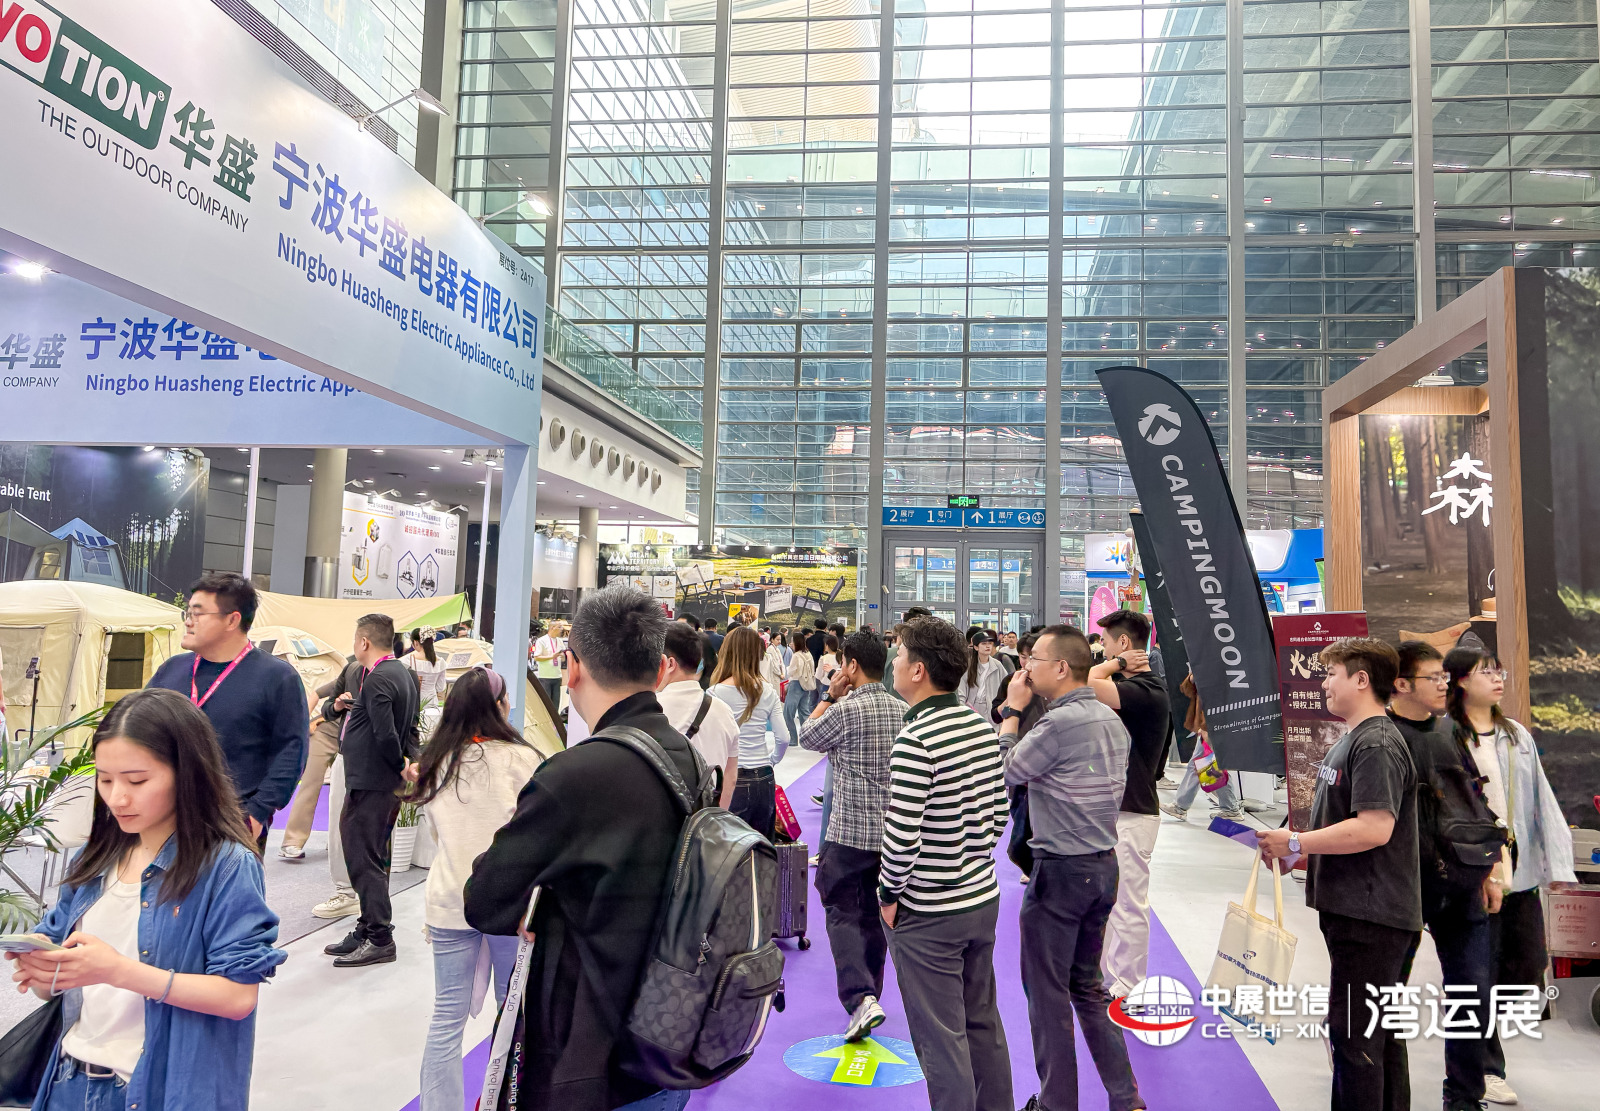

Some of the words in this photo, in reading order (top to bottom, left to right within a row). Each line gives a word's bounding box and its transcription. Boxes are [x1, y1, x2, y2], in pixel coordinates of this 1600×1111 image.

[38, 99, 77, 140] THE
[82, 127, 173, 193] OUTDOOR
[176, 181, 249, 233] COMPANY
[169, 100, 258, 203] 华盛
[272, 141, 538, 359] 宁波华盛电器有限公司
[520, 268, 534, 288] 2A17
[277, 232, 338, 287] Ningbo
[341, 273, 409, 331] Huasheng
[411, 309, 453, 349] Electric
[454, 333, 502, 375] Appliance
[521, 369, 535, 391] Ltd
[0, 333, 67, 370] 华盛
[80, 317, 278, 361] 宁波华盛
[3, 377, 60, 388] COMPANY
[86, 374, 150, 396] Ningbo
[154, 375, 245, 396] Huasheng
[249, 375, 316, 392] Electric
[320, 377, 361, 396] App
[0, 483, 25, 498] able
[27, 486, 51, 502] Tent
[1421, 452, 1493, 527] 森
[889, 509, 899, 522] 2
[926, 510, 935, 523] 1
[938, 510, 952, 519] 号门
[988, 511, 996, 524] 1
[1161, 454, 1250, 690] CAMPINGMOON
